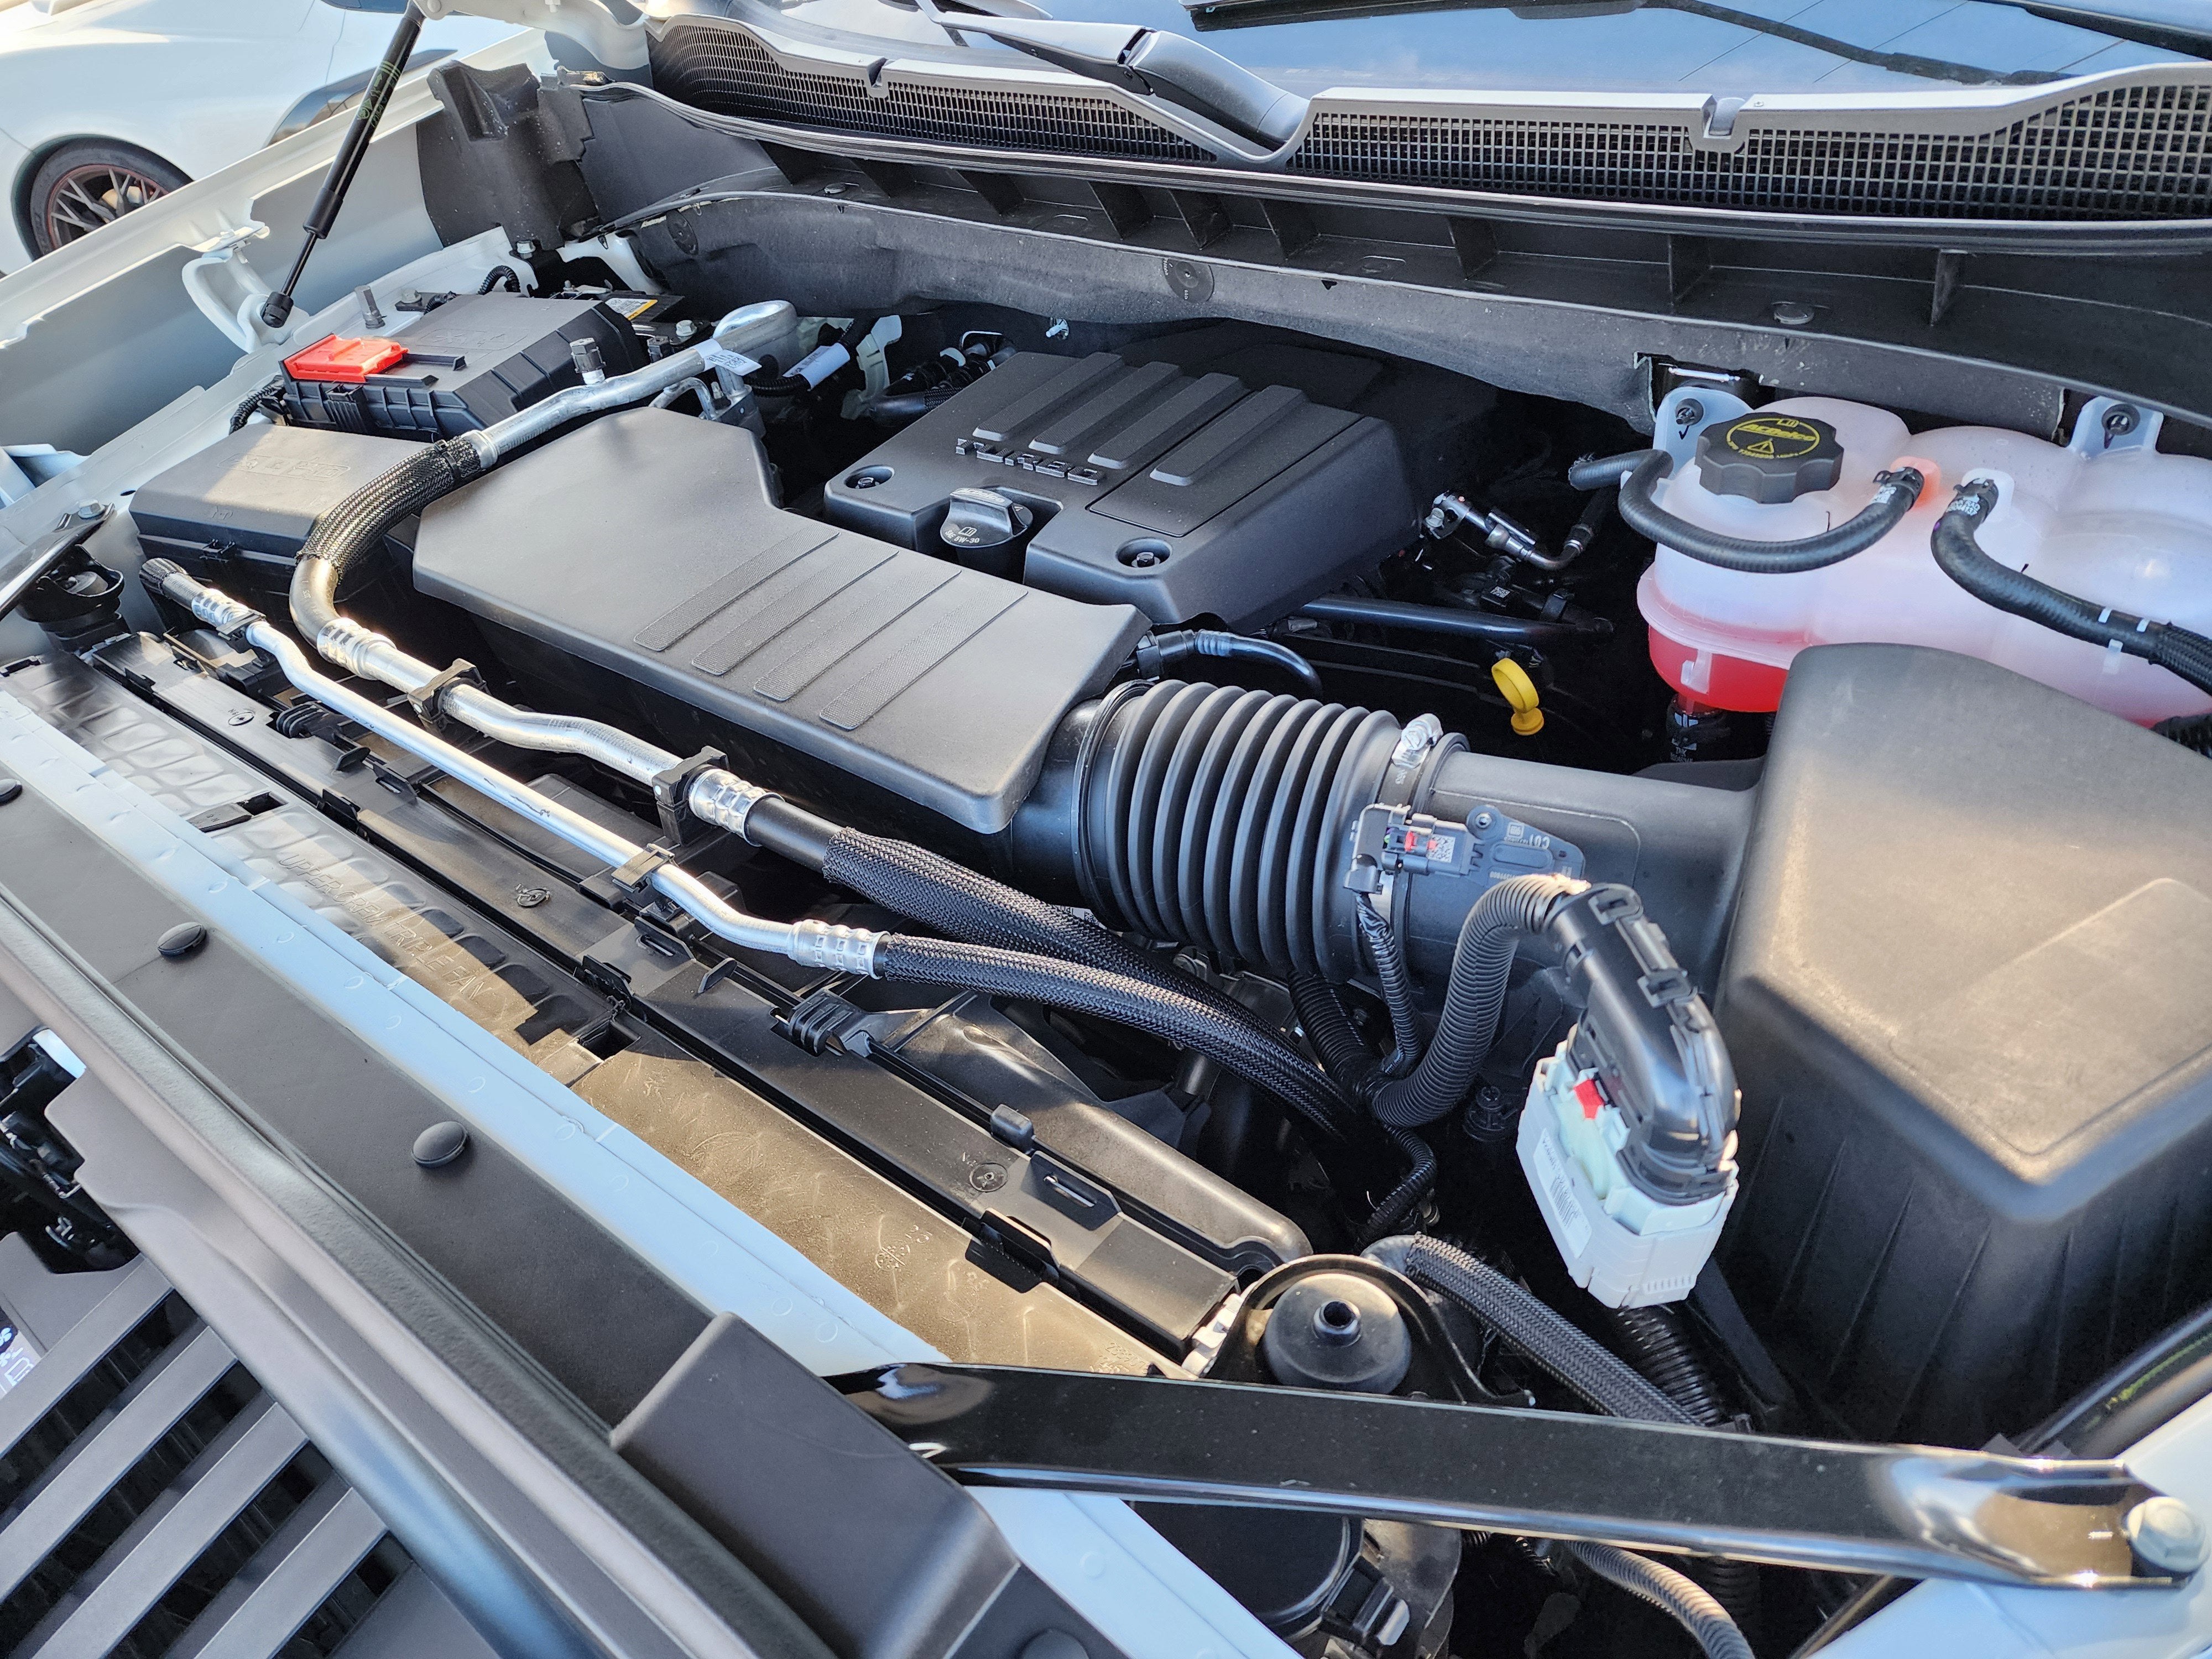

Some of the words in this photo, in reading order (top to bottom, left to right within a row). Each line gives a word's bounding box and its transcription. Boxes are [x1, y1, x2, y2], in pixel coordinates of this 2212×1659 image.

[955, 438, 1104, 486] TURBO
[278, 854, 344, 895] UPPER
[383, 919, 455, 973] TRIPLE
[443, 964, 493, 1001] FAN
